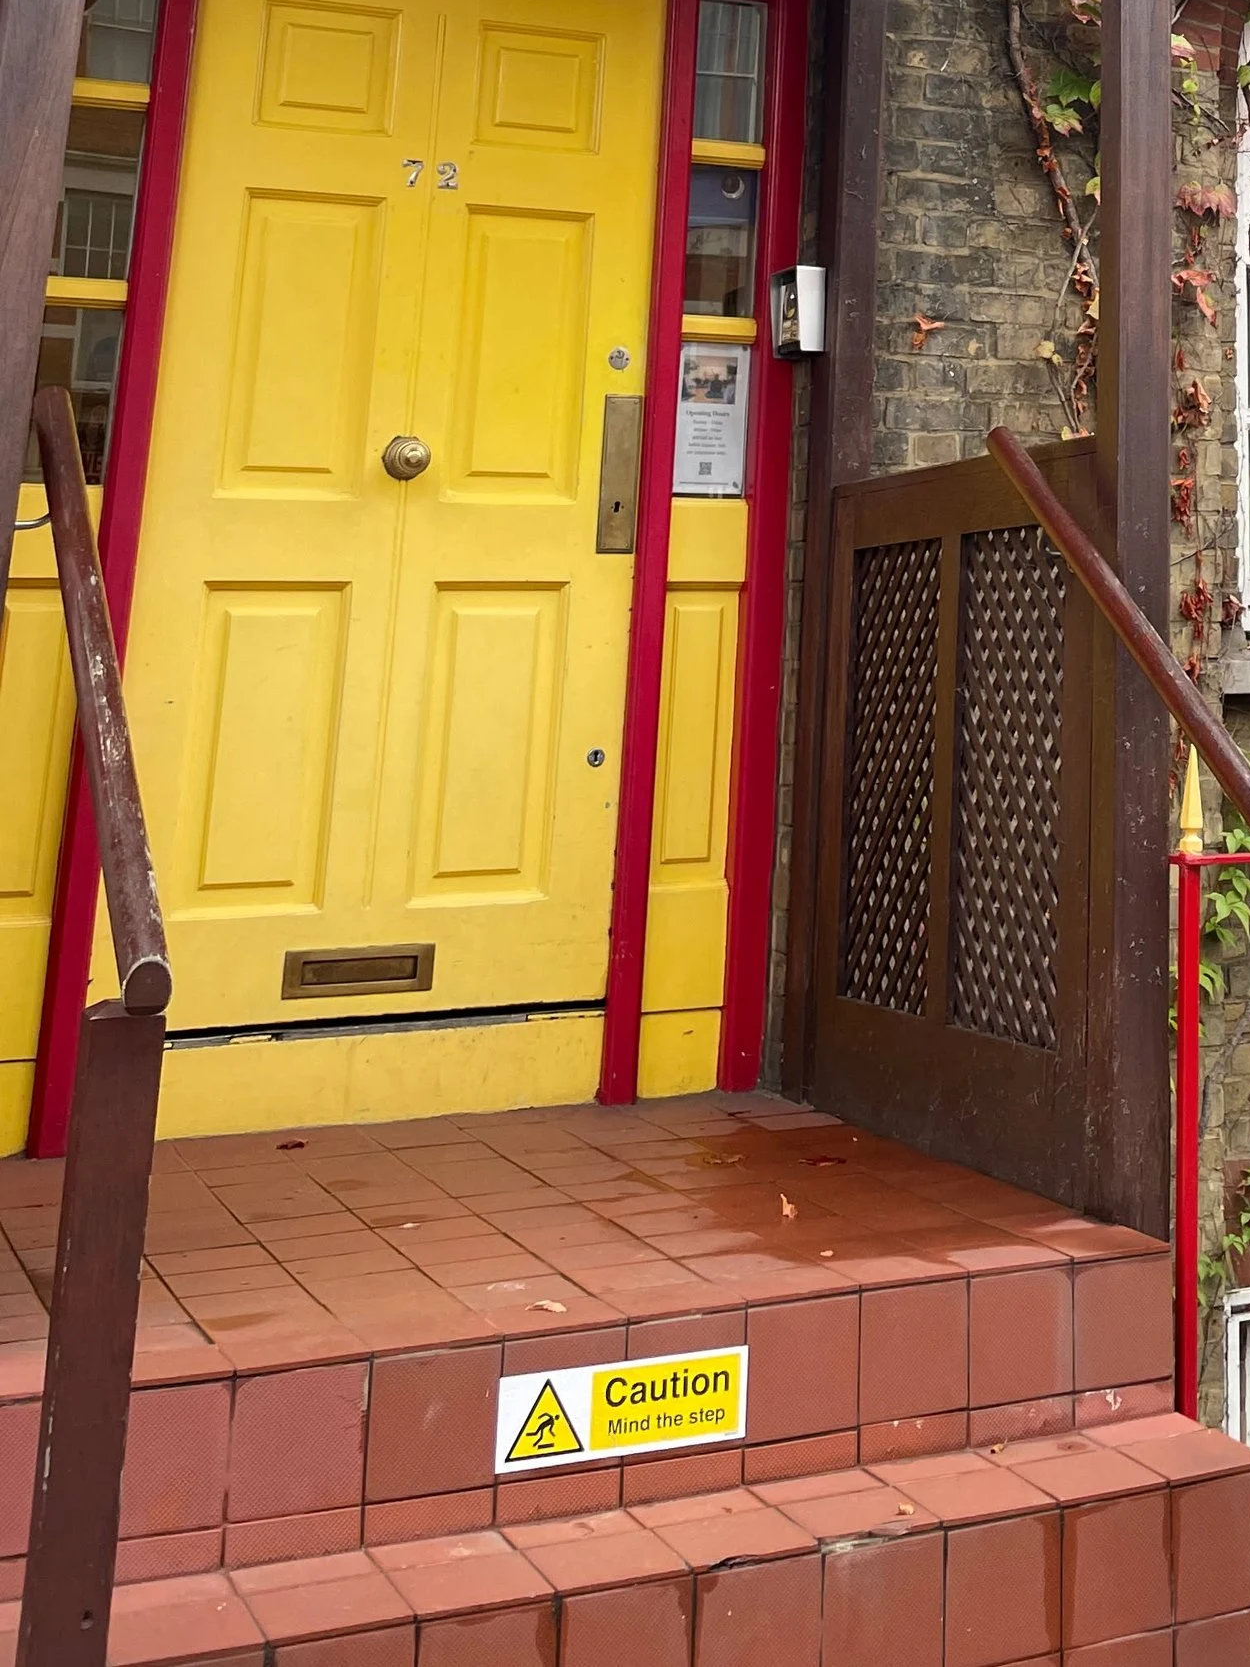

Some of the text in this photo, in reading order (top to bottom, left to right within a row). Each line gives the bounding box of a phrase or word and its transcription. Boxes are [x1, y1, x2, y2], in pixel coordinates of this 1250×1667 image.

[401, 159, 459, 190] 72
[605, 1368, 730, 1408] Caution
[608, 1405, 726, 1436] Mind the step
